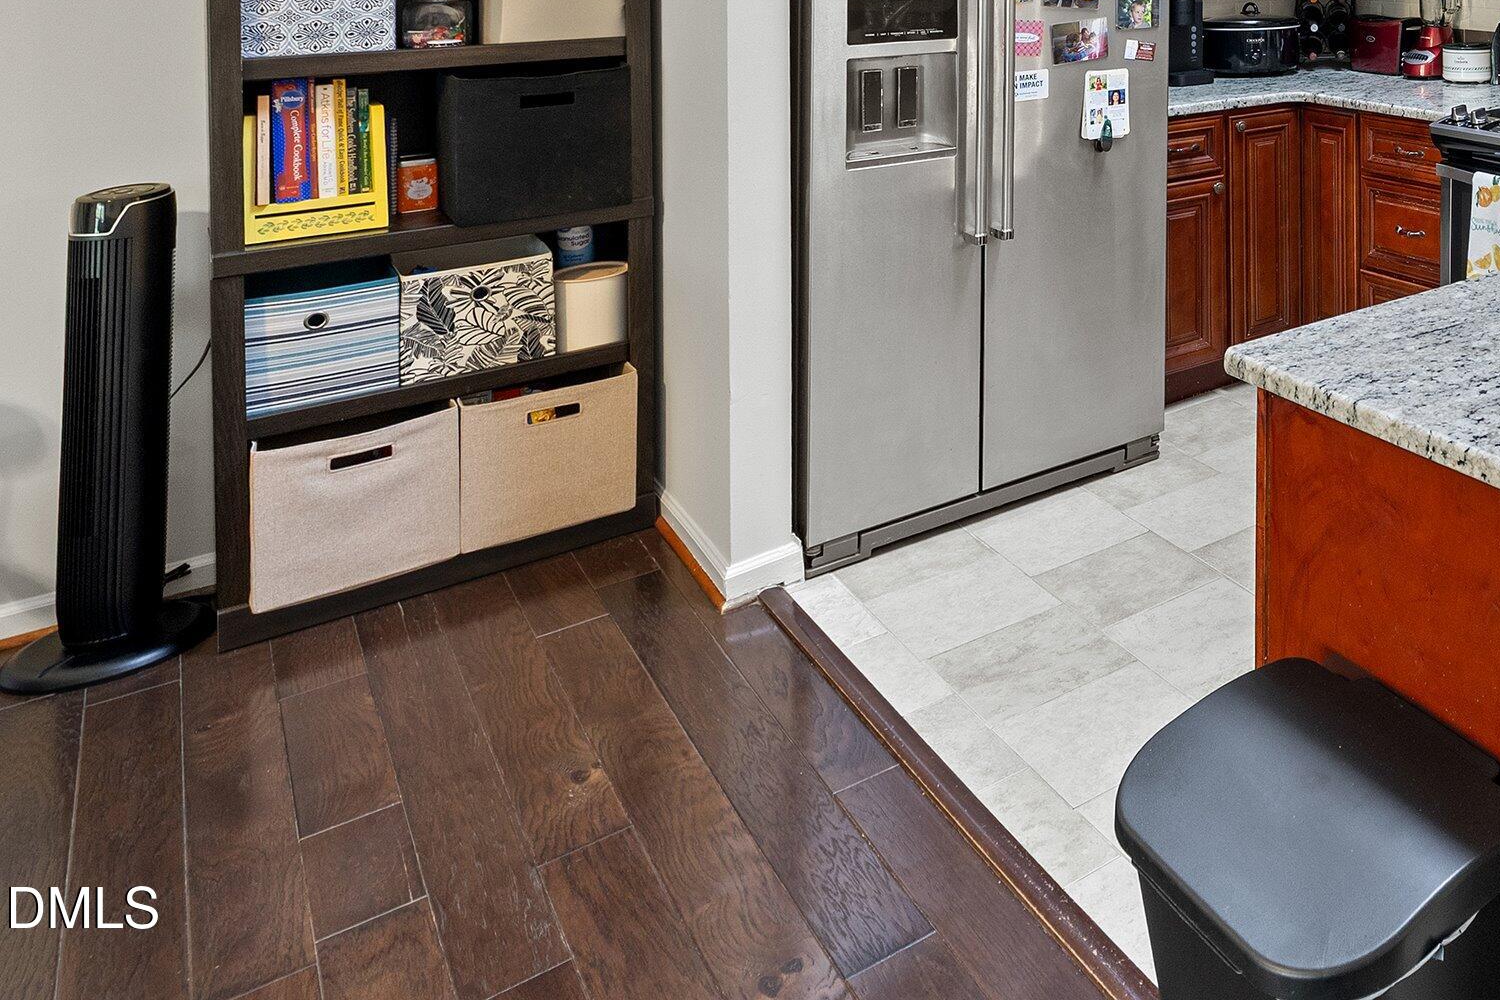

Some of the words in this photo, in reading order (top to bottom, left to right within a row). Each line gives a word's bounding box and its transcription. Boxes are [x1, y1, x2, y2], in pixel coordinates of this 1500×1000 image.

[1019, 73, 1038, 81] MAKE
[1019, 80, 1044, 89] IMPACT
[320, 92, 331, 124] Atkins
[289, 109, 302, 143] Complete
[321, 125, 332, 139] for
[321, 140, 333, 160] Life
[347, 134, 357, 152] Cook's
[292, 144, 303, 181] Cookbook
